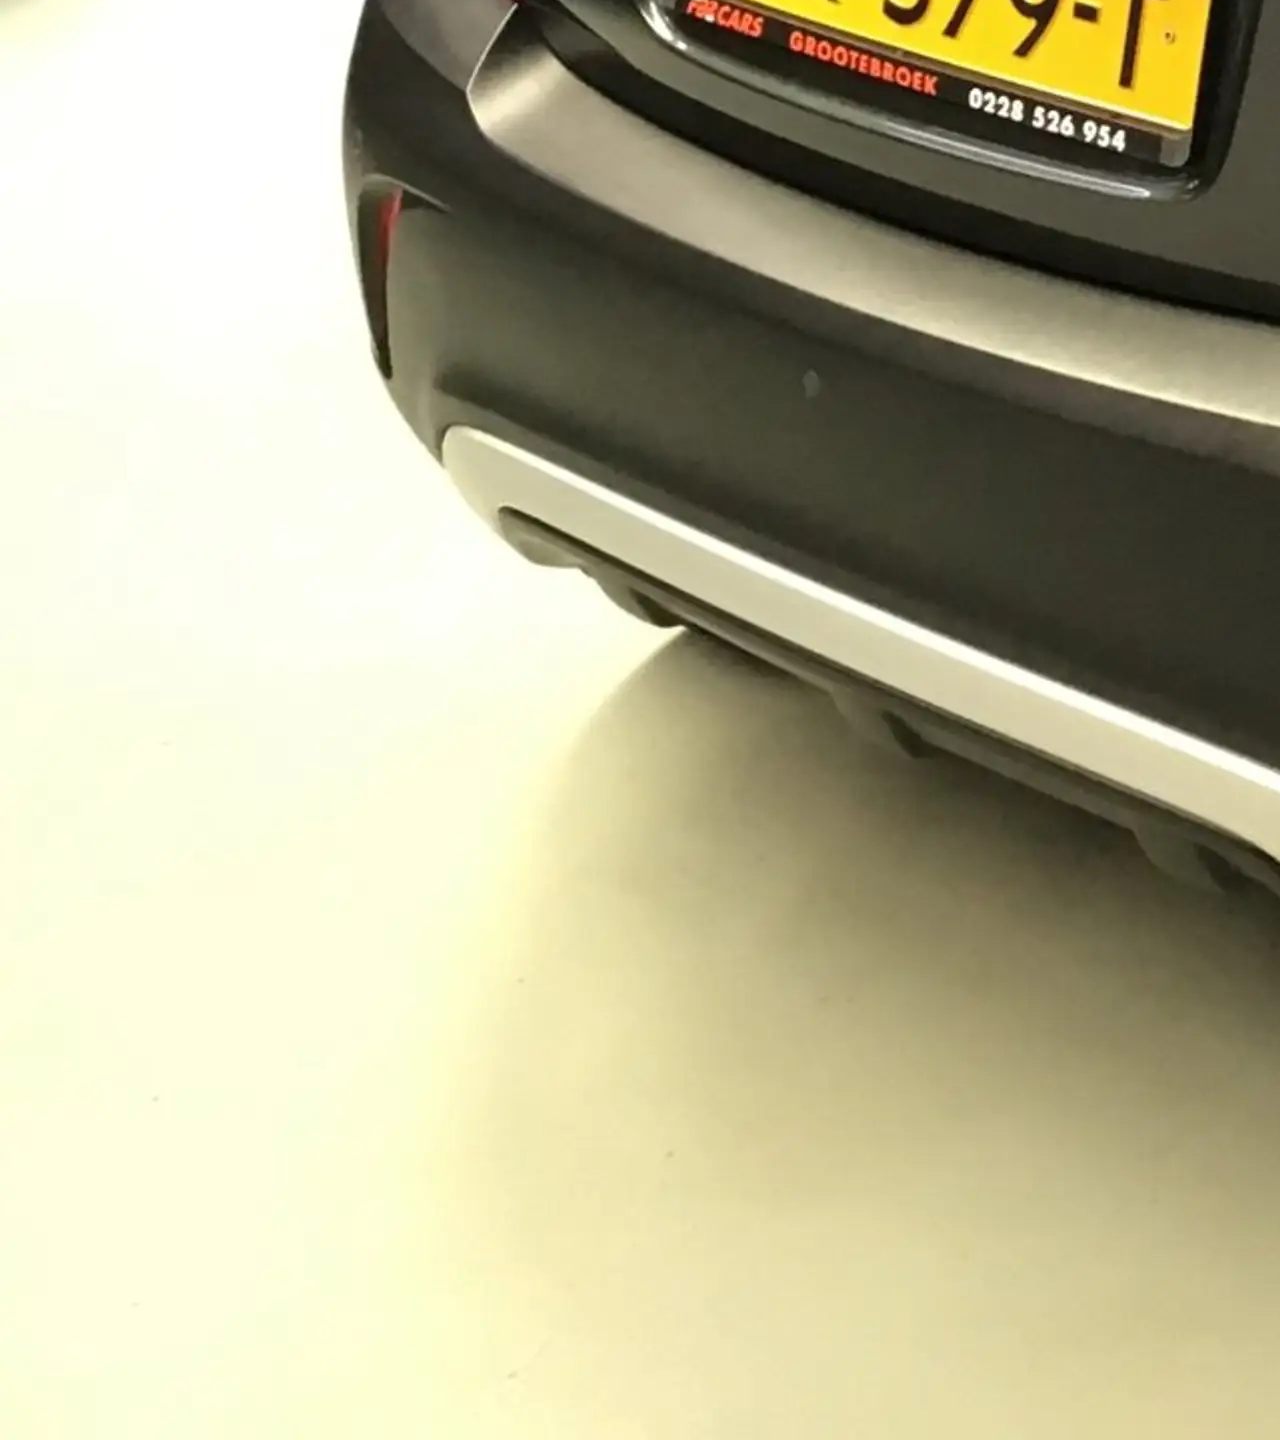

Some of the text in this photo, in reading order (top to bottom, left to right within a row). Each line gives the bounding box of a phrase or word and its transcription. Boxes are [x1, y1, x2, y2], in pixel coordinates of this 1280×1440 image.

[788, 30, 939, 96] GROOTEBROEK
[967, 87, 1127, 152] 0228 526 954
